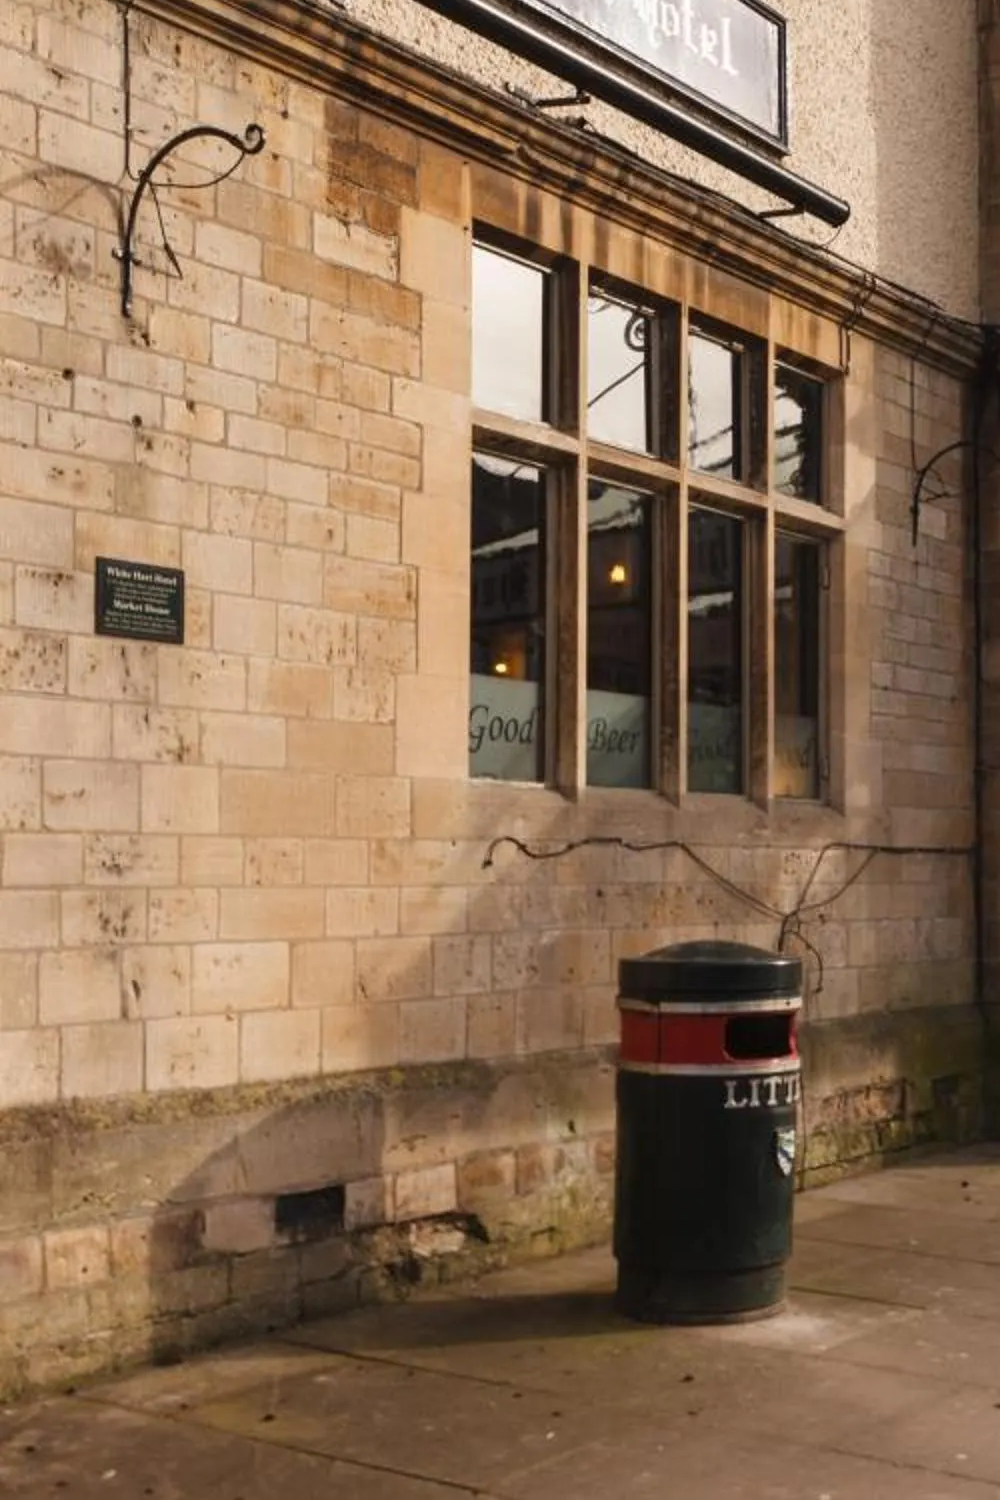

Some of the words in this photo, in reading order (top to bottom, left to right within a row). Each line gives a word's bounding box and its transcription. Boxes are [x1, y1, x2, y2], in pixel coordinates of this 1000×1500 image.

[469, 703, 540, 754] Good
[588, 717, 641, 754] Beer
[723, 1072, 800, 1109] LITT
